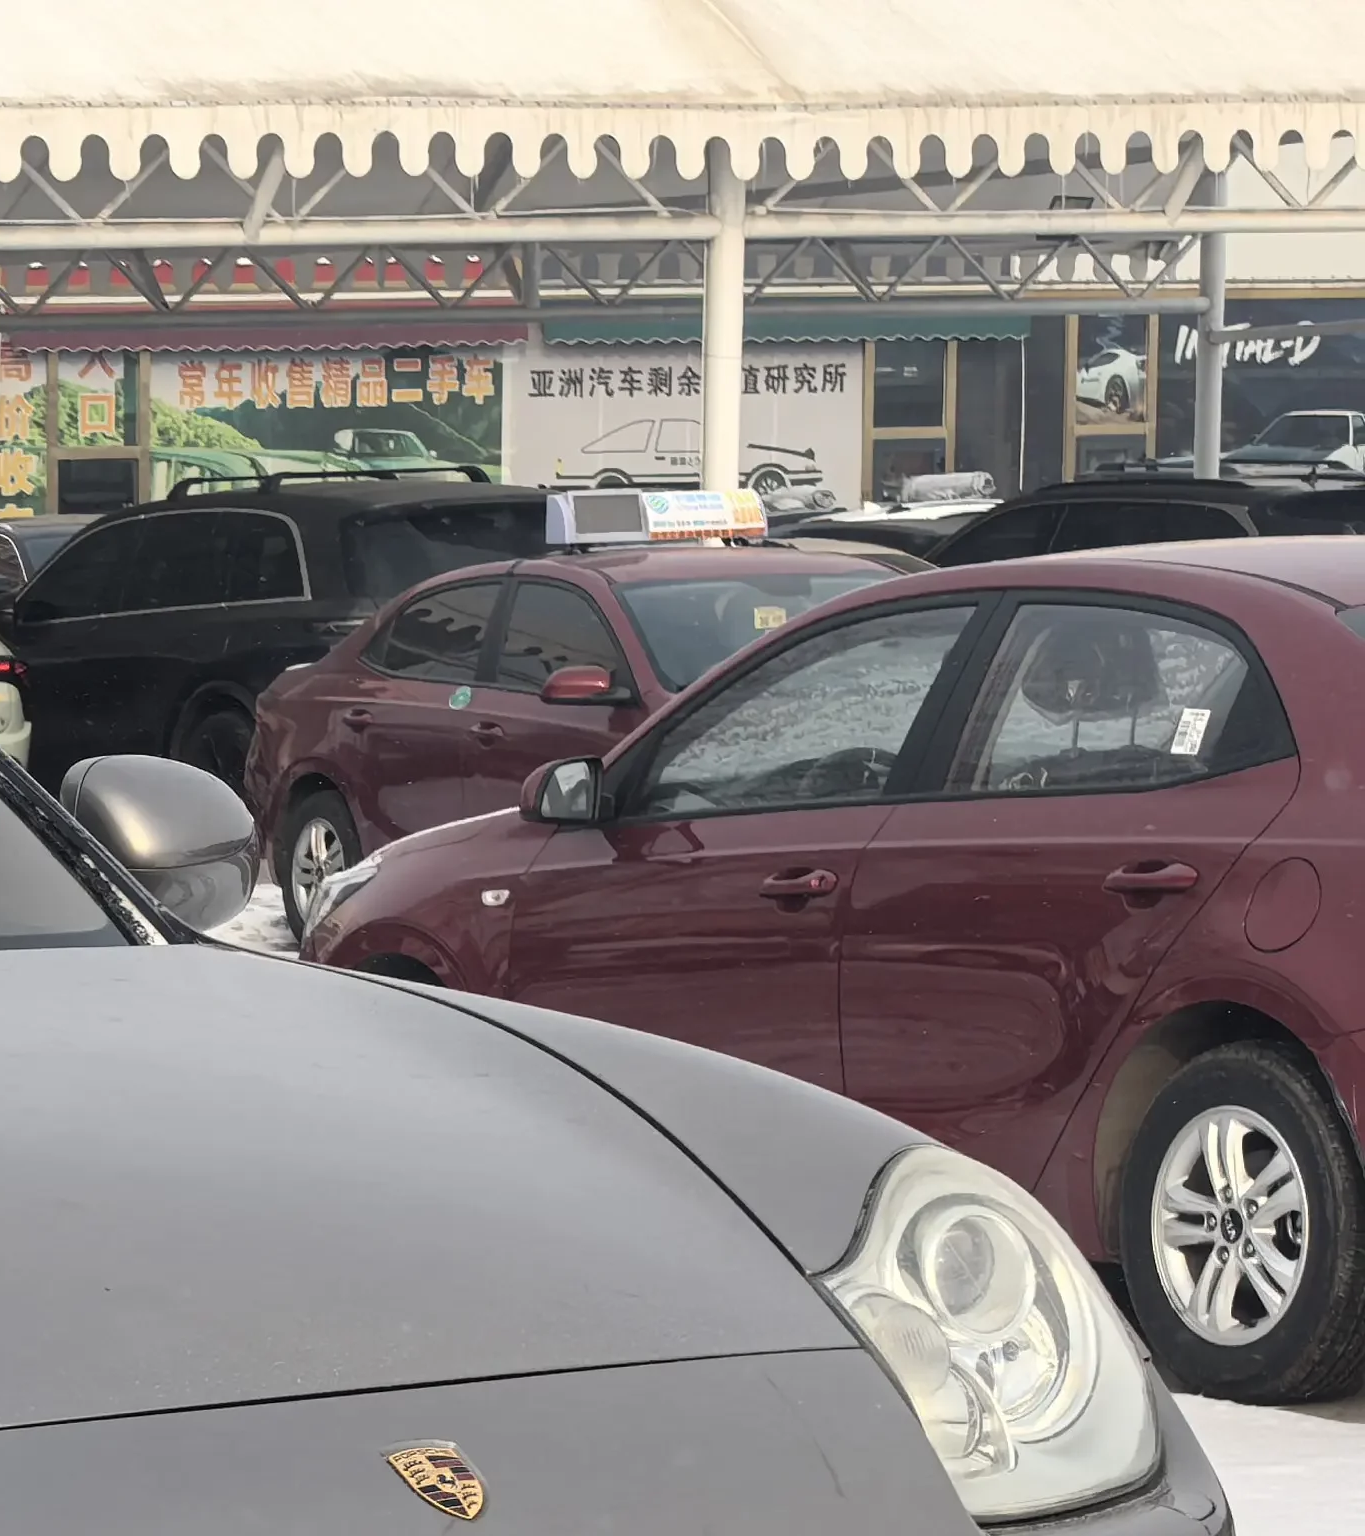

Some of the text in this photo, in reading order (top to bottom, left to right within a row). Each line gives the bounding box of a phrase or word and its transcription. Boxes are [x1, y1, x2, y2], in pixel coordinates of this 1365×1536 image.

[1174, 320, 1321, 368] ITIAL-D
[178, 356, 495, 409] 常年收售精品二手车
[528, 362, 847, 398] 亚洲汽车剩余值研究所
